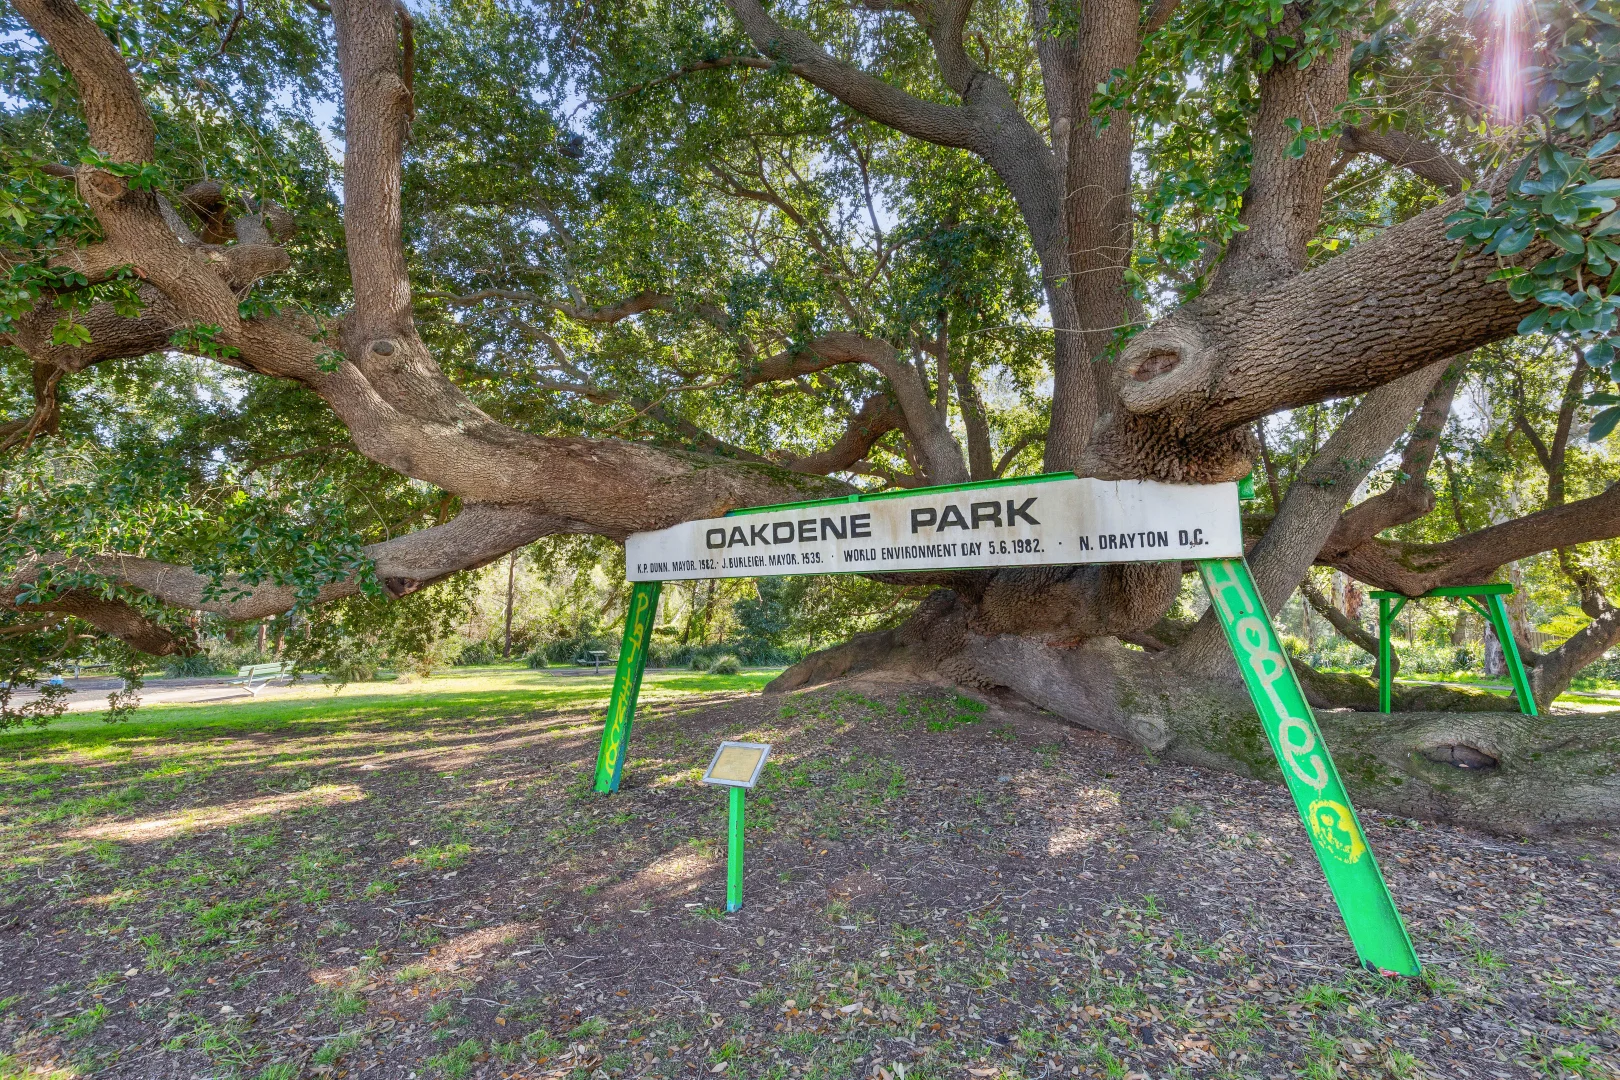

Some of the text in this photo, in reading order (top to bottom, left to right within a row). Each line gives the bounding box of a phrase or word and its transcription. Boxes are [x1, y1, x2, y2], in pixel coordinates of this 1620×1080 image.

[705, 497, 1042, 550] OAKDENE PARK
[768, 553, 800, 567] MAYOR.
[843, 547, 877, 563] WORLD
[881, 543, 958, 560] ENVIRONMENT
[961, 541, 982, 557] DAY
[989, 538, 1045, 555] 5.6.1982.
[1079, 535, 1094, 551] N.
[1099, 530, 1169, 550] DRAYTON
[1178, 528, 1209, 547] D.C.
